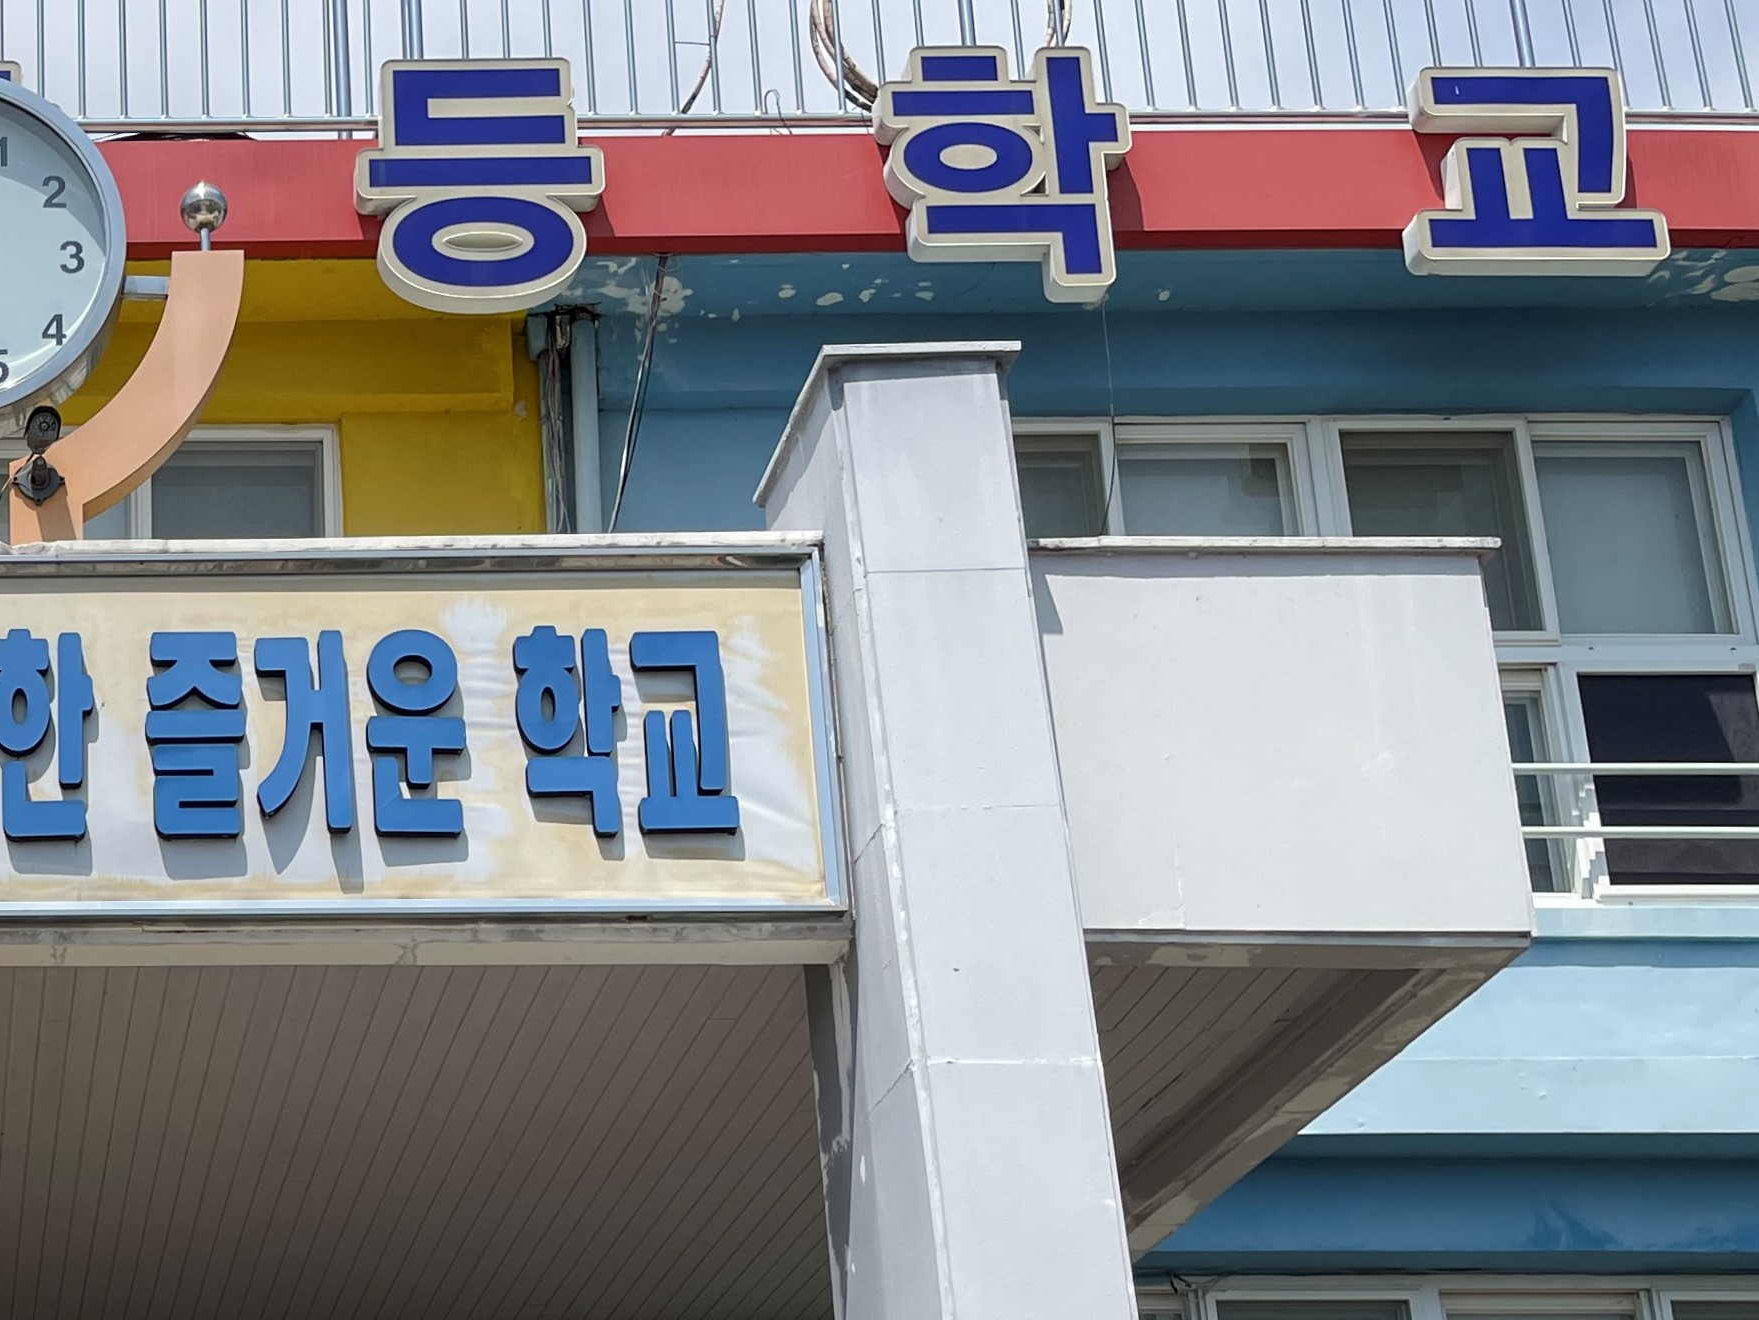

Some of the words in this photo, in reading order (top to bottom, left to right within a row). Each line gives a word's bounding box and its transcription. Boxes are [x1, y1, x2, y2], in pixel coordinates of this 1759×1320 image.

[42, 176, 68, 209] 2
[59, 242, 85, 275] 3
[42, 314, 68, 346] 4
[144, 628, 469, 838] 즐거운
[513, 624, 742, 837] 학교
